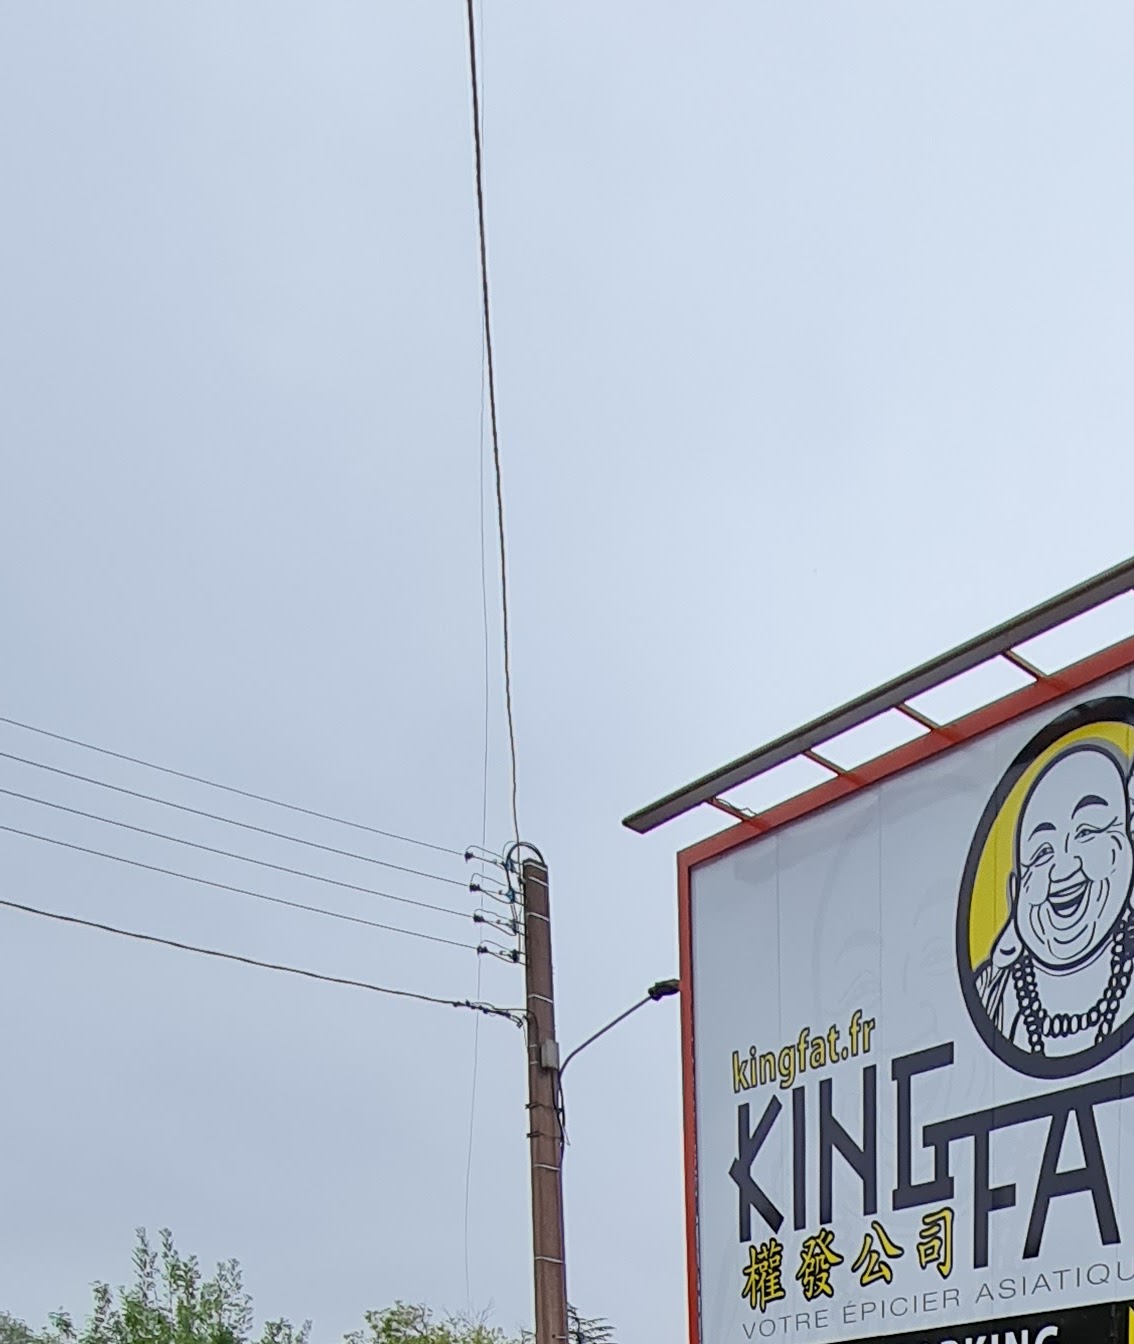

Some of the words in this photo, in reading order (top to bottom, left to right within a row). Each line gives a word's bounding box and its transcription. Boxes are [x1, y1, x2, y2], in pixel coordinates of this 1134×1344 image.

[732, 1008, 876, 1094] kingfat.fr
[741, 1206, 955, 1313] 權發公司
[742, 1309, 829, 1339] VOTRE
[843, 1288, 961, 1324] ÉPICIER
